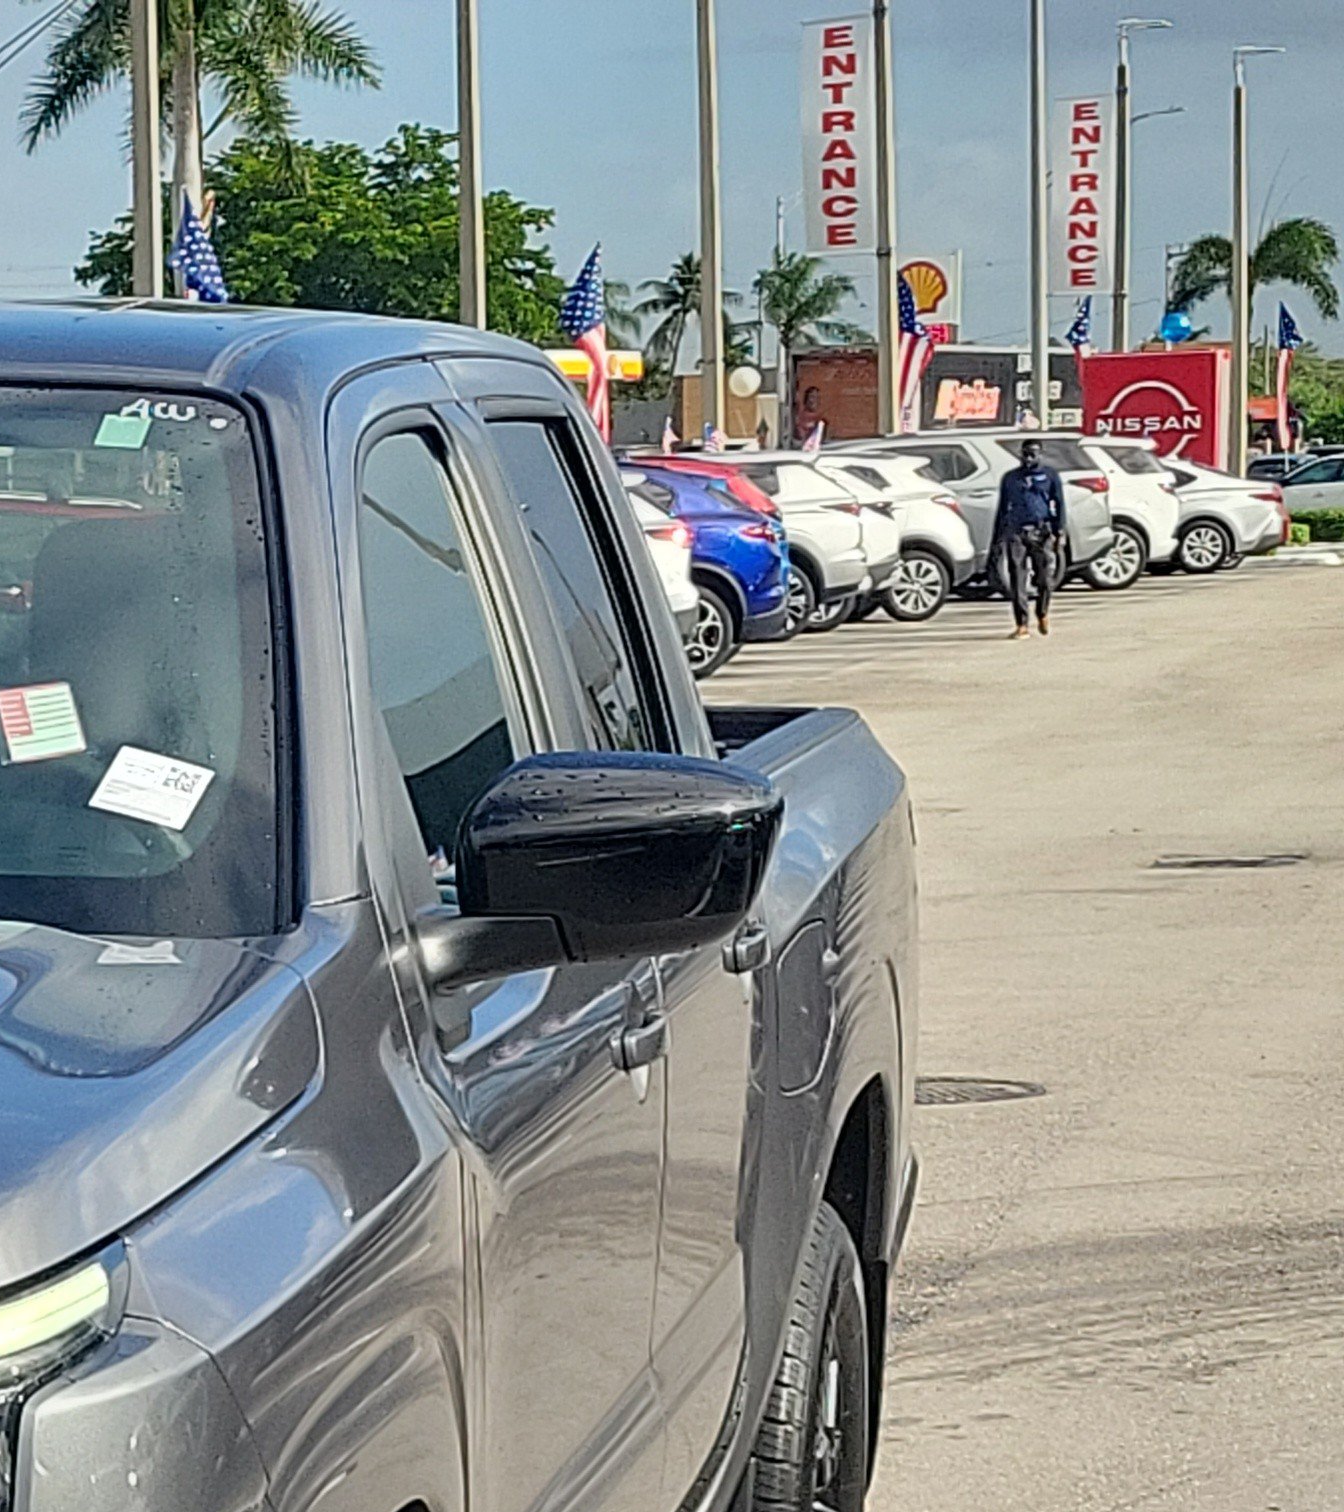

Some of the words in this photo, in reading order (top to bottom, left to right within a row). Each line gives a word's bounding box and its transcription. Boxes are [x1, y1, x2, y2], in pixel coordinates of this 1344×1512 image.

[822, 26, 859, 246] ENTRANCE
[1067, 102, 1101, 287] ENTRANCE
[1095, 414, 1202, 433] NISSAN
